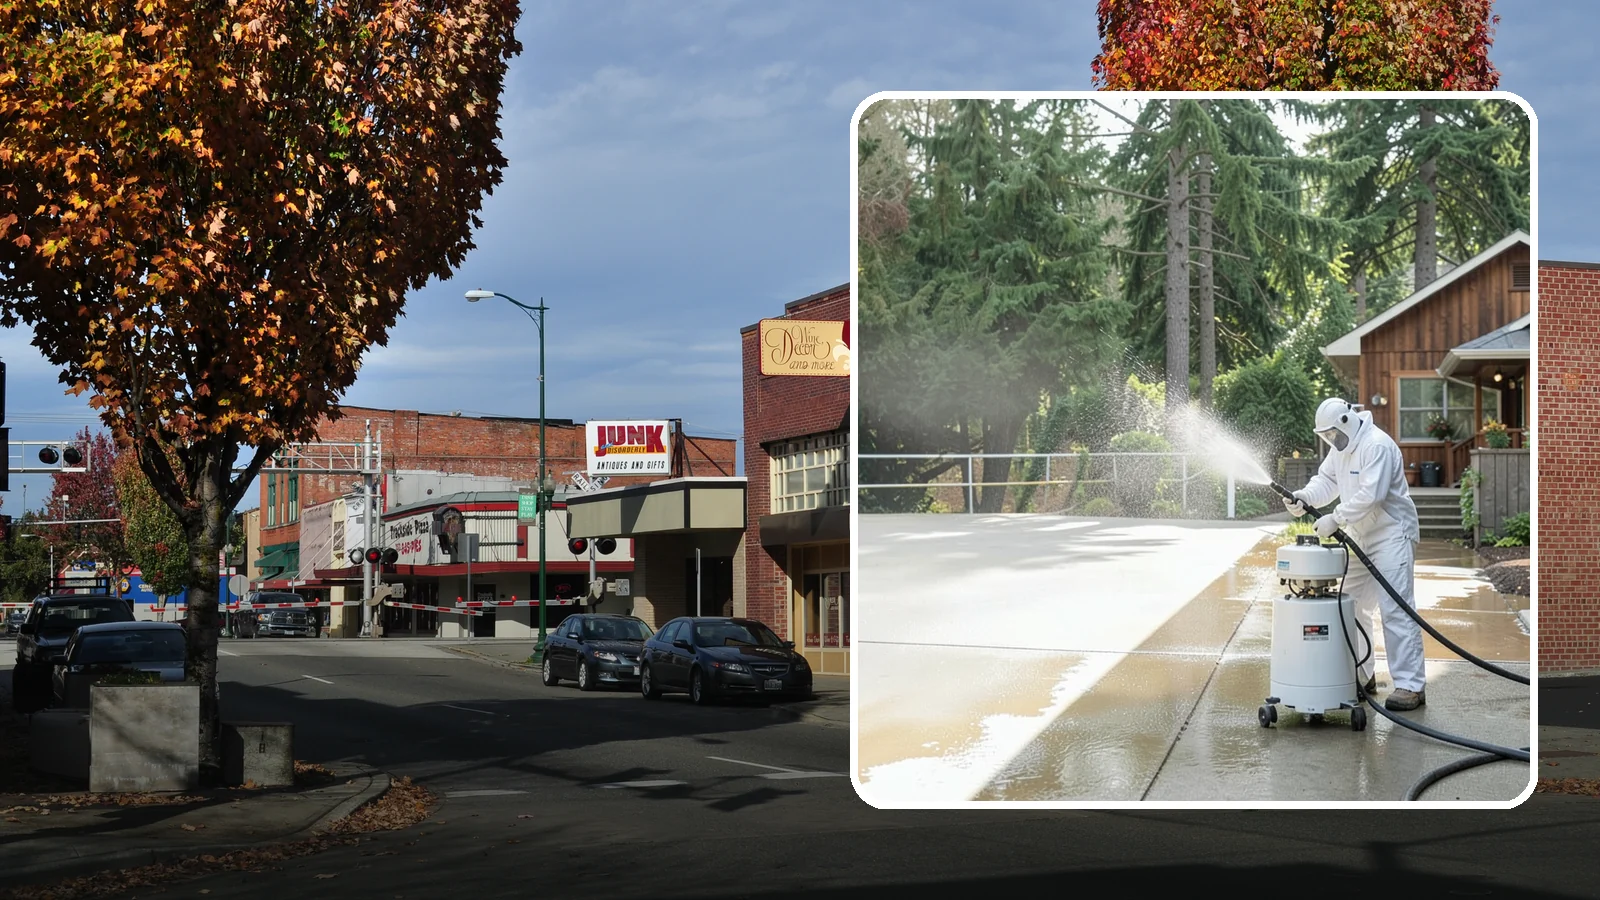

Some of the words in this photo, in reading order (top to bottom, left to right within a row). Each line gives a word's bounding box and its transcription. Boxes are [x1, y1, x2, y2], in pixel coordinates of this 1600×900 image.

[596, 425, 664, 457] JUNK
[607, 446, 646, 454] DISORDERLY
[597, 461, 628, 470] ANTIQUES
[631, 461, 643, 470] AND
[647, 460, 665, 469] GIFTS
[414, 519, 429, 535] Pizza
